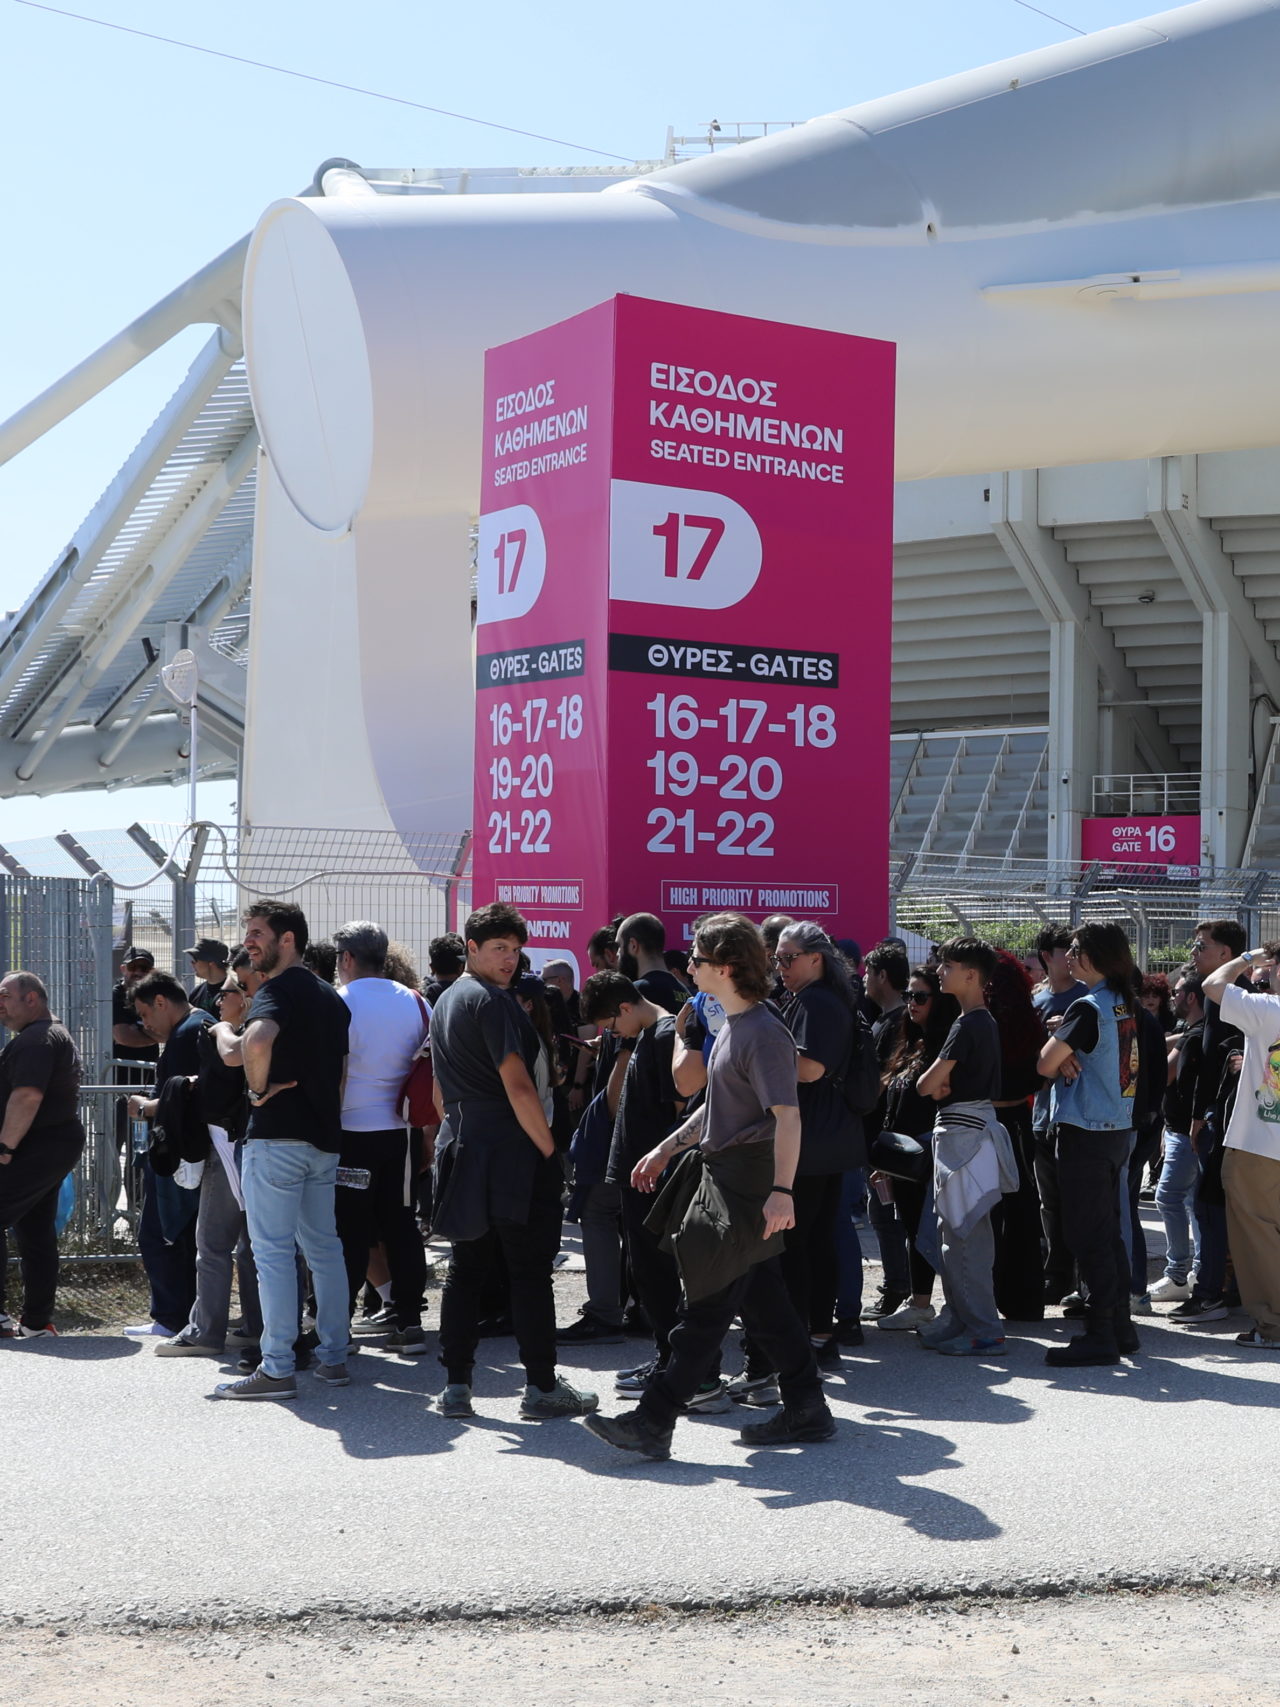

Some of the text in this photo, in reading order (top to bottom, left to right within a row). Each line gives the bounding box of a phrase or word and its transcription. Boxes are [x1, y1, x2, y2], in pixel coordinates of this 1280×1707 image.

[496, 379, 555, 422] ΕΙΣΟΔΟΣ
[650, 362, 777, 407] ΕΙΣΟΔΟΣ
[495, 405, 587, 458] ΚΑΘΗΜΕΝΩΝ
[649, 400, 843, 453] ΚΑΘΗΜΕΝΩΝ
[495, 443, 587, 486] SEATED ENTRANCE
[650, 439, 844, 484] SEATED ENTRANCE
[493, 528, 527, 595] 17
[652, 511, 726, 581] 17
[489, 694, 583, 746] 16-17-18
[646, 692, 837, 748] 16-17-18
[489, 753, 554, 800] 19-20
[646, 750, 783, 801] 19-20
[488, 808, 552, 854] 21-22
[646, 807, 775, 856] 21-22
[1112, 826, 1142, 837] ΘΥΡΑ
[1112, 841, 1142, 852] GATE
[1145, 825, 1176, 852] 16
[513, 885, 540, 903] PRIORITY
[541, 885, 580, 904] PROMOTIONS
[670, 887, 830, 908] HIGH PRIORITY PROMOTIONS
[526, 920, 570, 938] NATION
